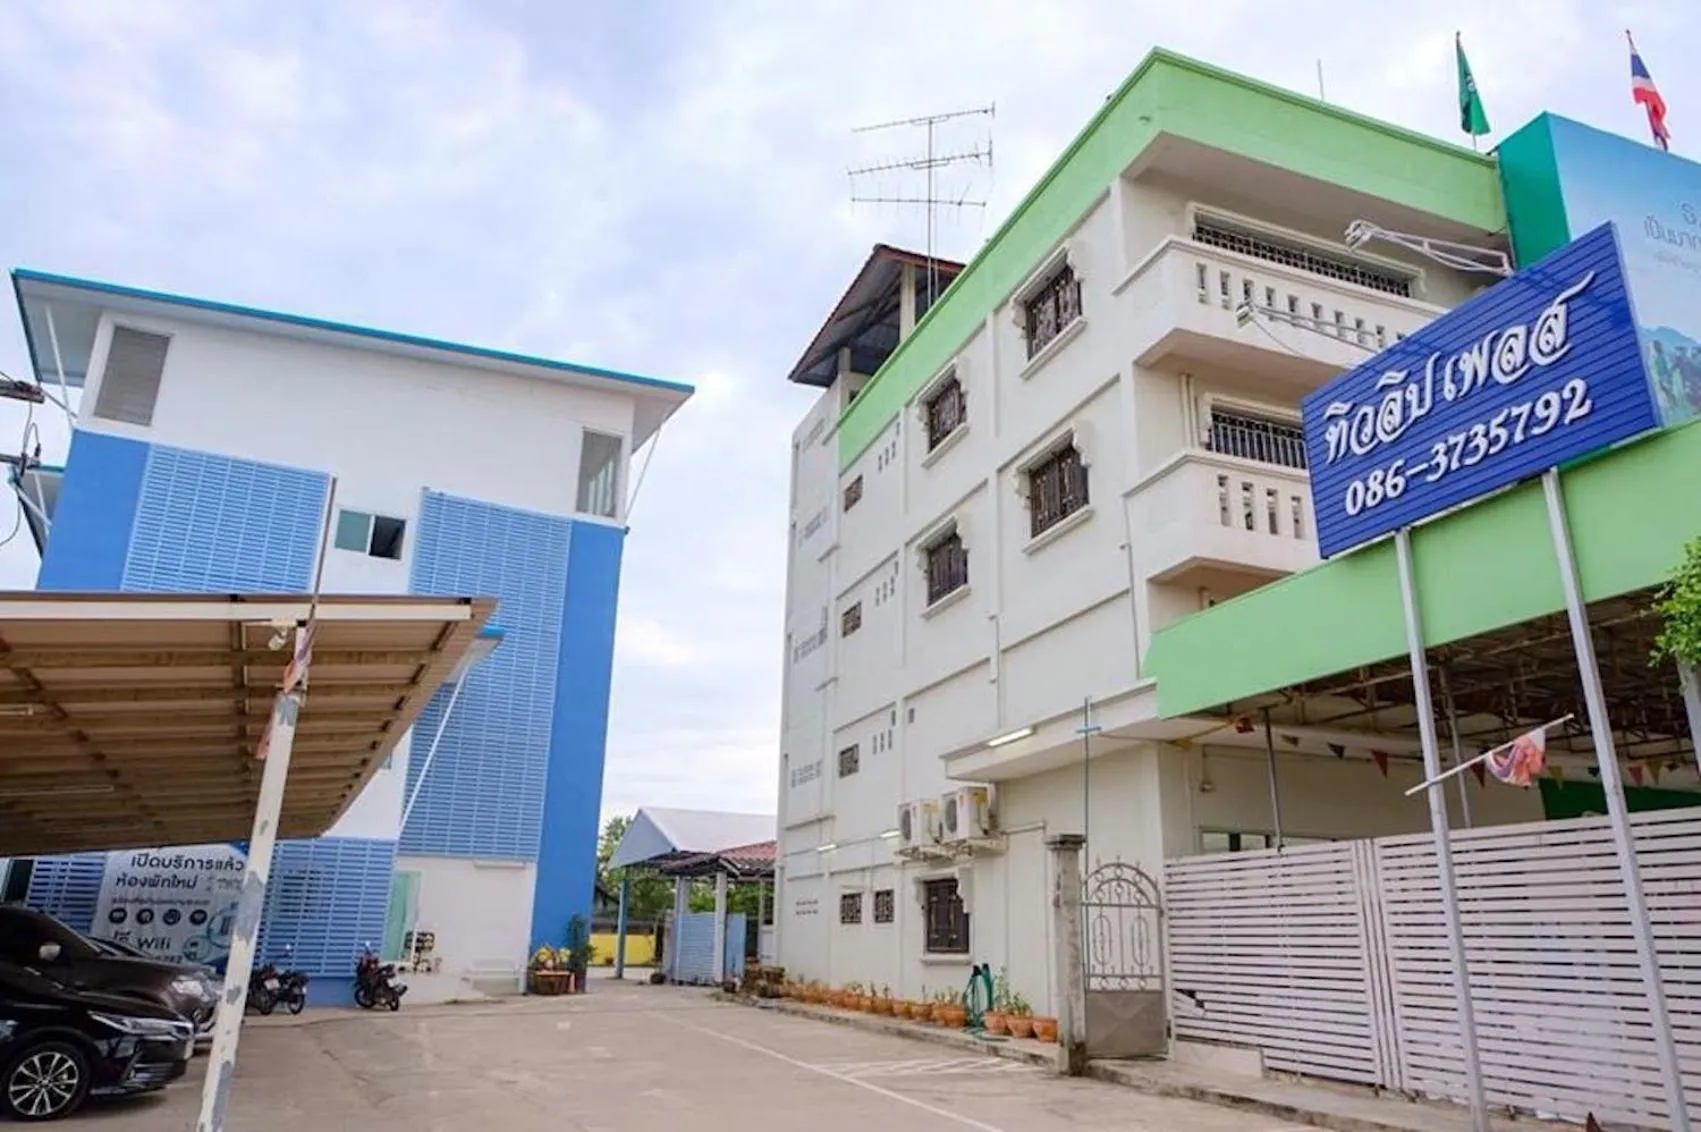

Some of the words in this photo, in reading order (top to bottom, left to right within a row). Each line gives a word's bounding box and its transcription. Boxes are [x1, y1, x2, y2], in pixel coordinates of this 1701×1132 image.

[1345, 378, 1593, 516] 086-3735792
[131, 853, 245, 871] เปิดบริการแล้ว
[116, 871, 199, 890] ห้องพักใหม่
